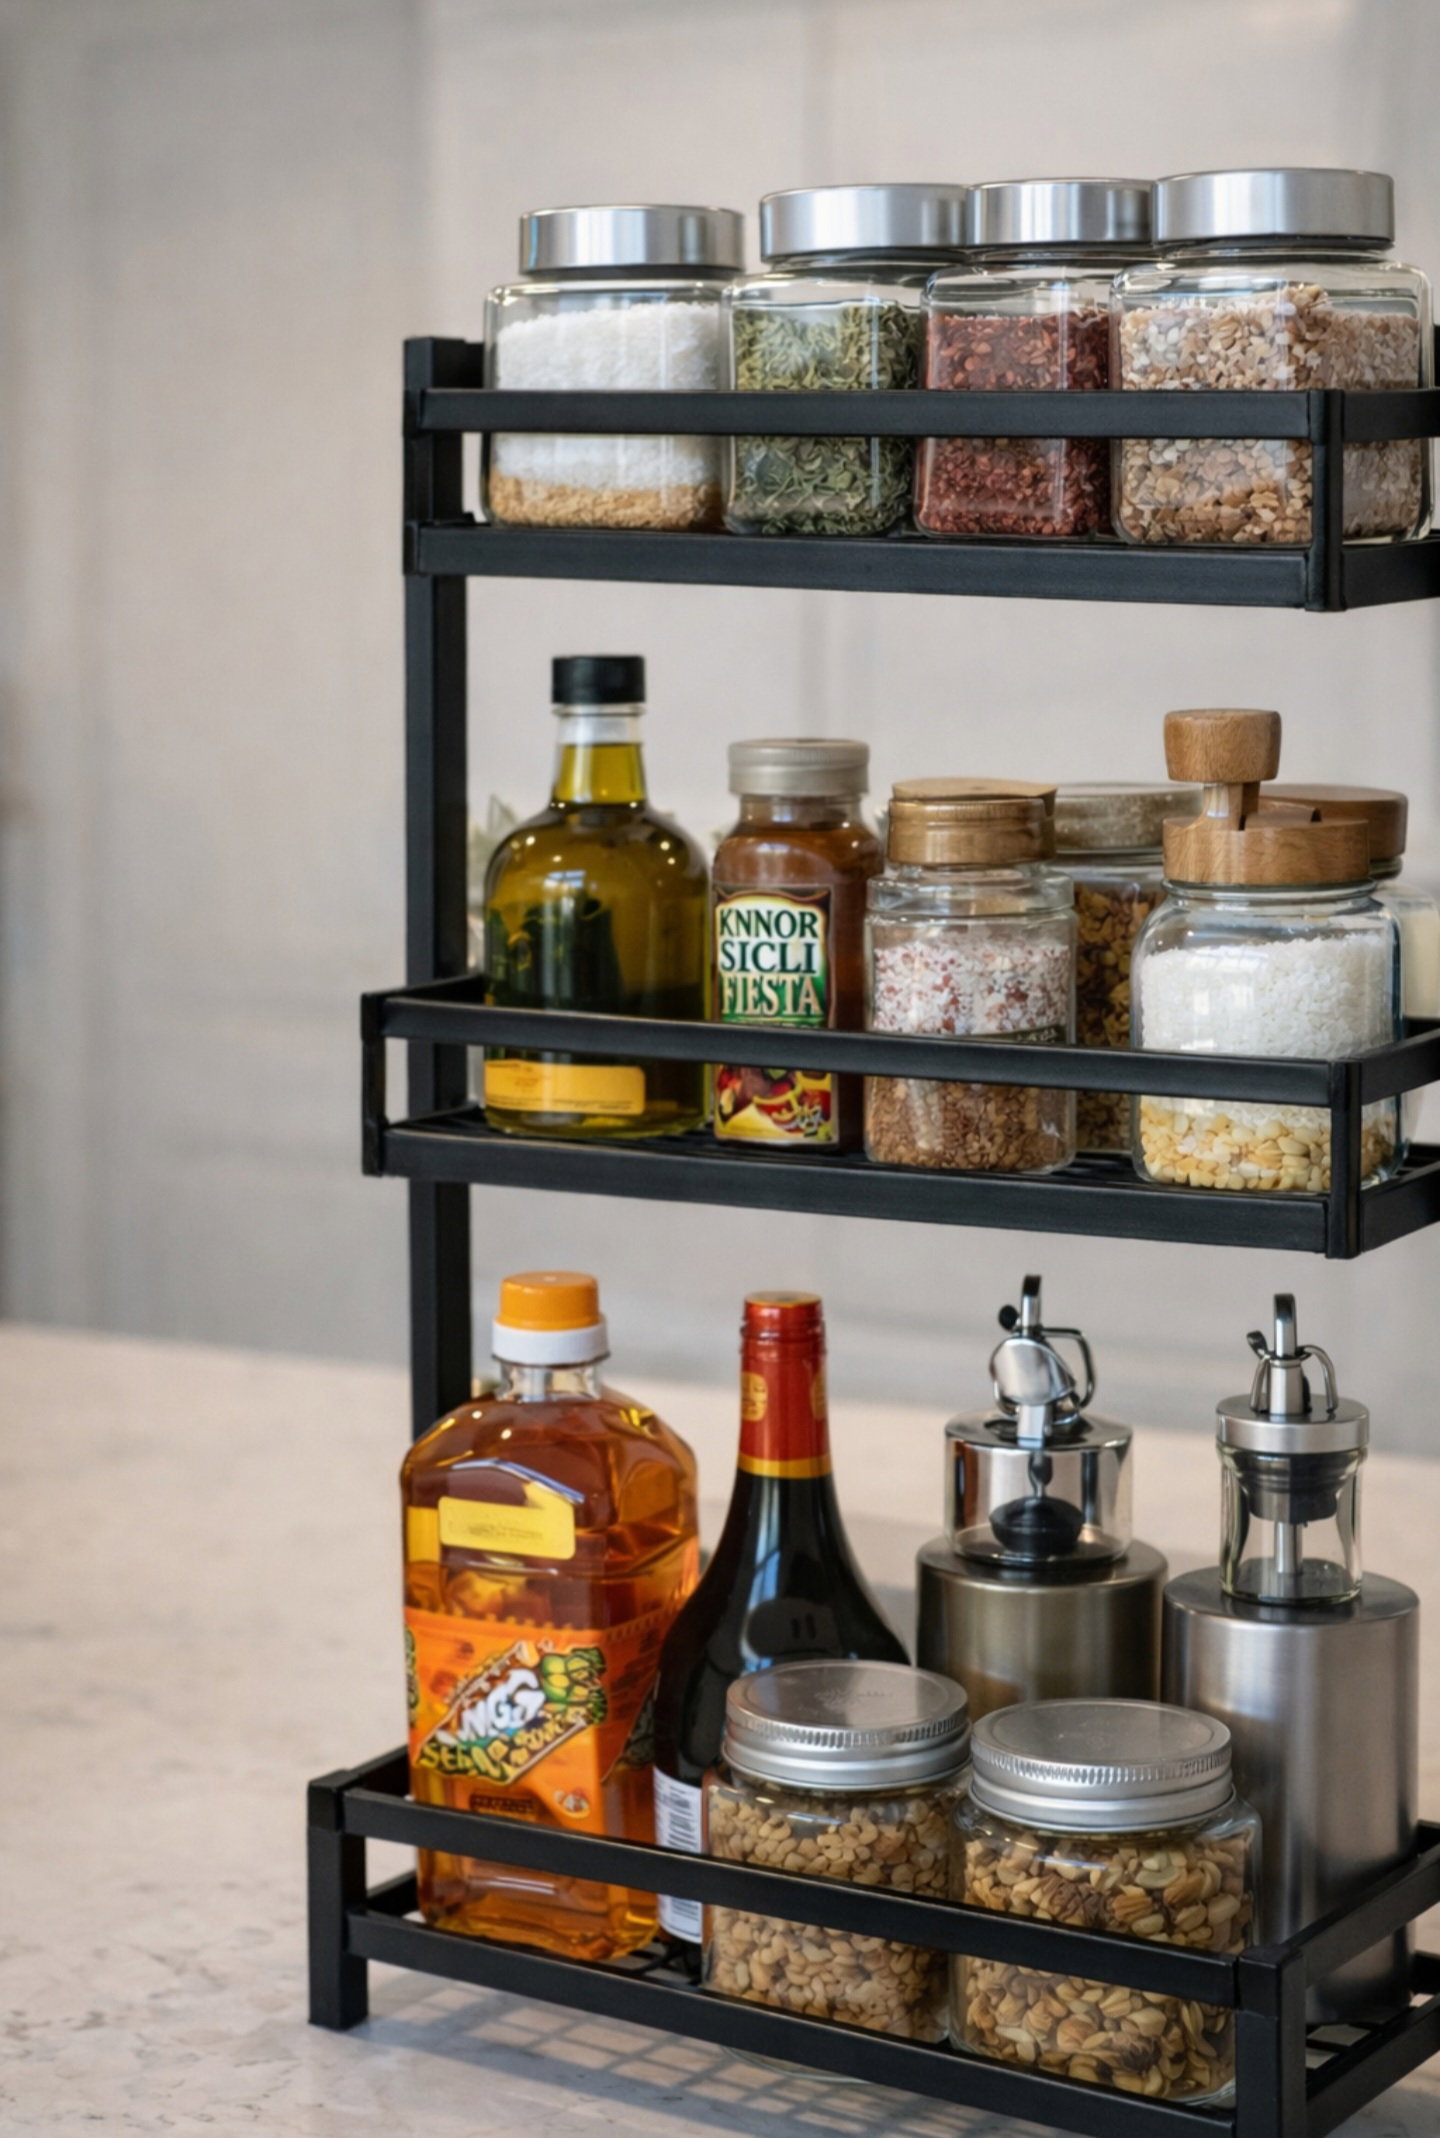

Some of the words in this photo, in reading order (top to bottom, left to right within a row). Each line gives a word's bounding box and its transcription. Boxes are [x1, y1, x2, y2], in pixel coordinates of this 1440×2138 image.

[720, 909, 818, 938] KNNOR
[721, 940, 816, 973] SICLI
[721, 973, 823, 1016] FIESTA
